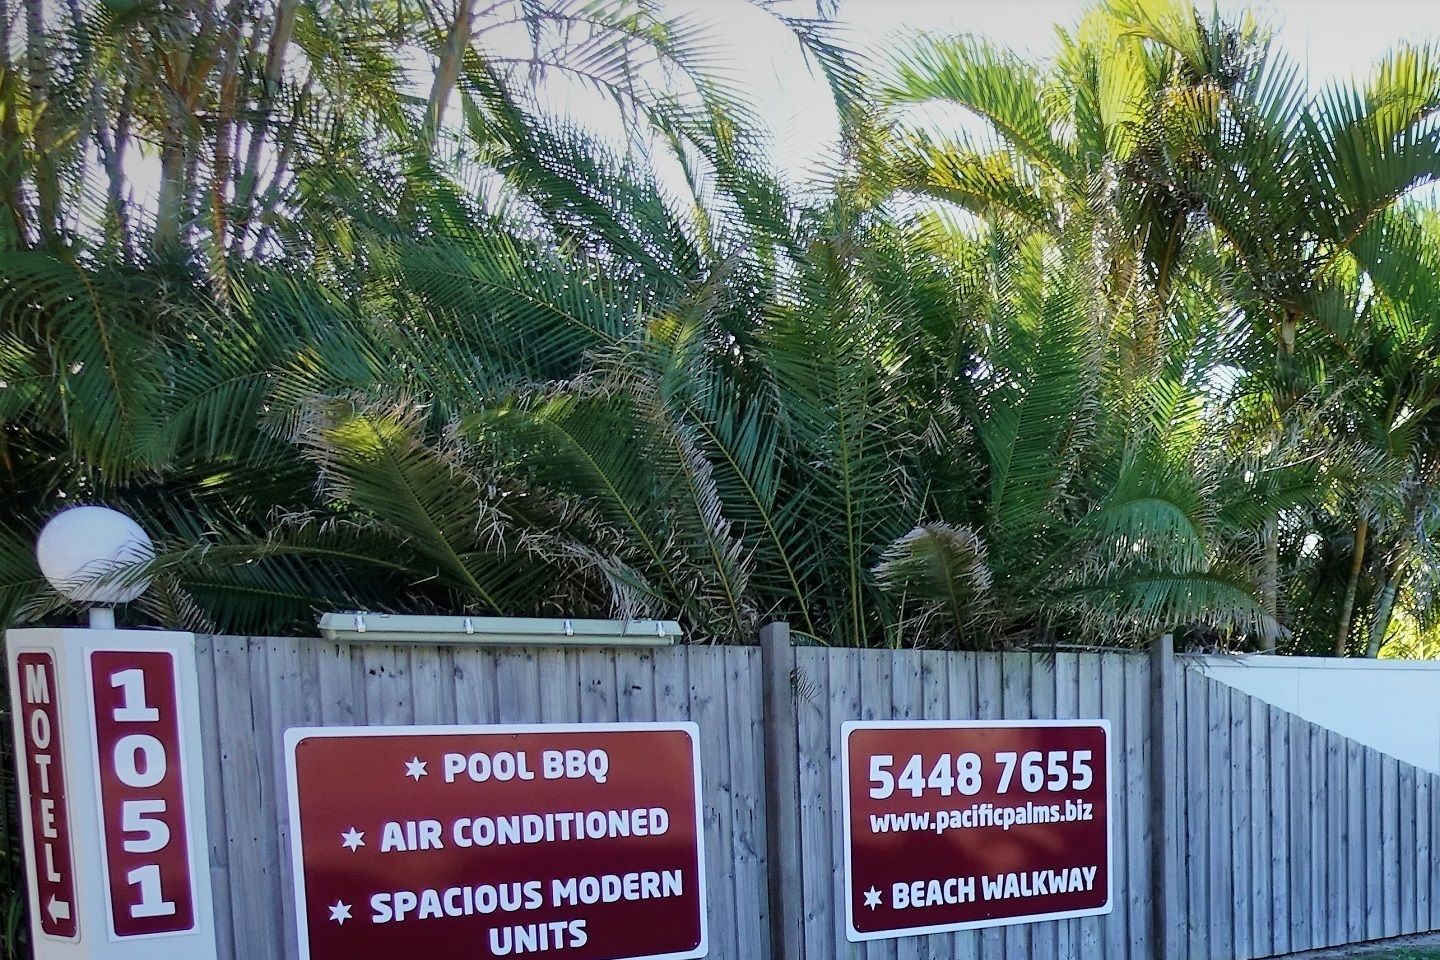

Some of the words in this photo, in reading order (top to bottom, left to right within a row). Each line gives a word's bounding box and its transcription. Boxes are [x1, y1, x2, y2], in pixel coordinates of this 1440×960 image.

[25, 664, 61, 883] MOTEL
[444, 751, 535, 783] POOL
[542, 748, 610, 783] BBQ
[868, 752, 983, 800] 5448
[995, 750, 1093, 794] 7655
[110, 668, 176, 919] 1051
[869, 798, 1093, 834] www.pacificpalms.biz
[380, 818, 444, 853] AIR
[452, 807, 670, 848] CONDITIONED
[370, 881, 543, 924] SPACIOUS
[552, 869, 684, 907] MODERN
[892, 876, 976, 910] BEACH
[981, 865, 1098, 901] WALKWAY
[489, 919, 589, 956] UNITS
